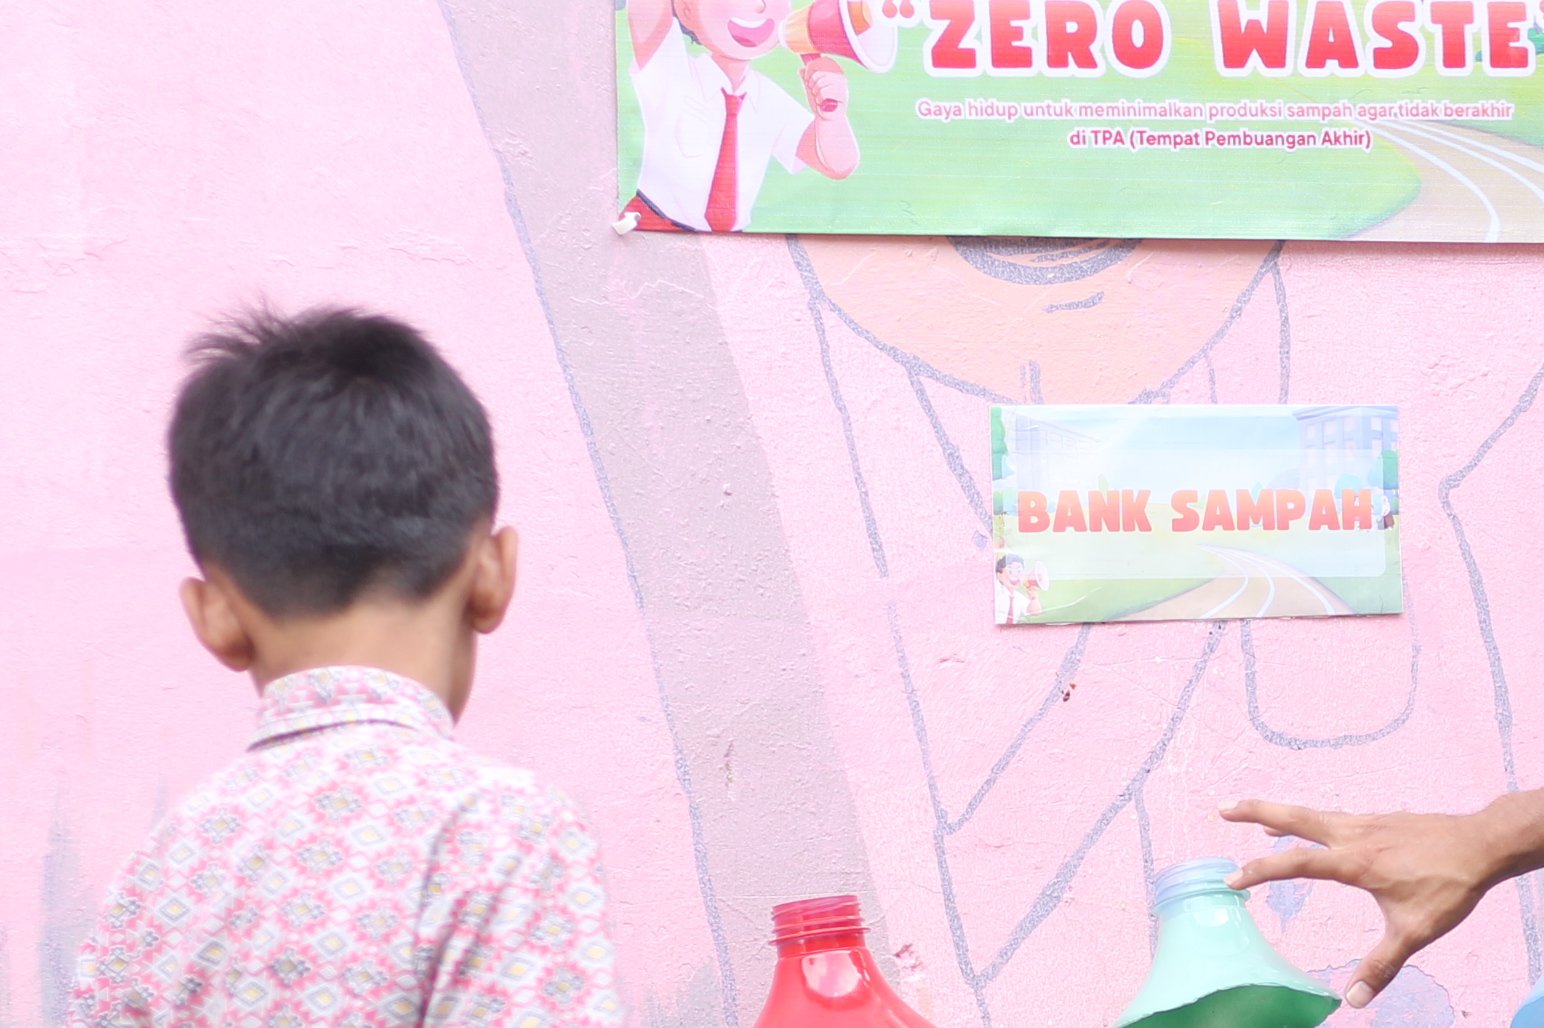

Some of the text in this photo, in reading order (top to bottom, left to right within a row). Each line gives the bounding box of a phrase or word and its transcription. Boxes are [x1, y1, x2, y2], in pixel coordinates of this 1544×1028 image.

[917, 99, 1512, 122] Gaya hidup untuk meminimalkan produksi sampah agar tidak berakhir
[1069, 129, 1372, 151] di TPA (Tempat Pembuangan Akhir)
[1016, 488, 1373, 534] BANK SAMPAH
